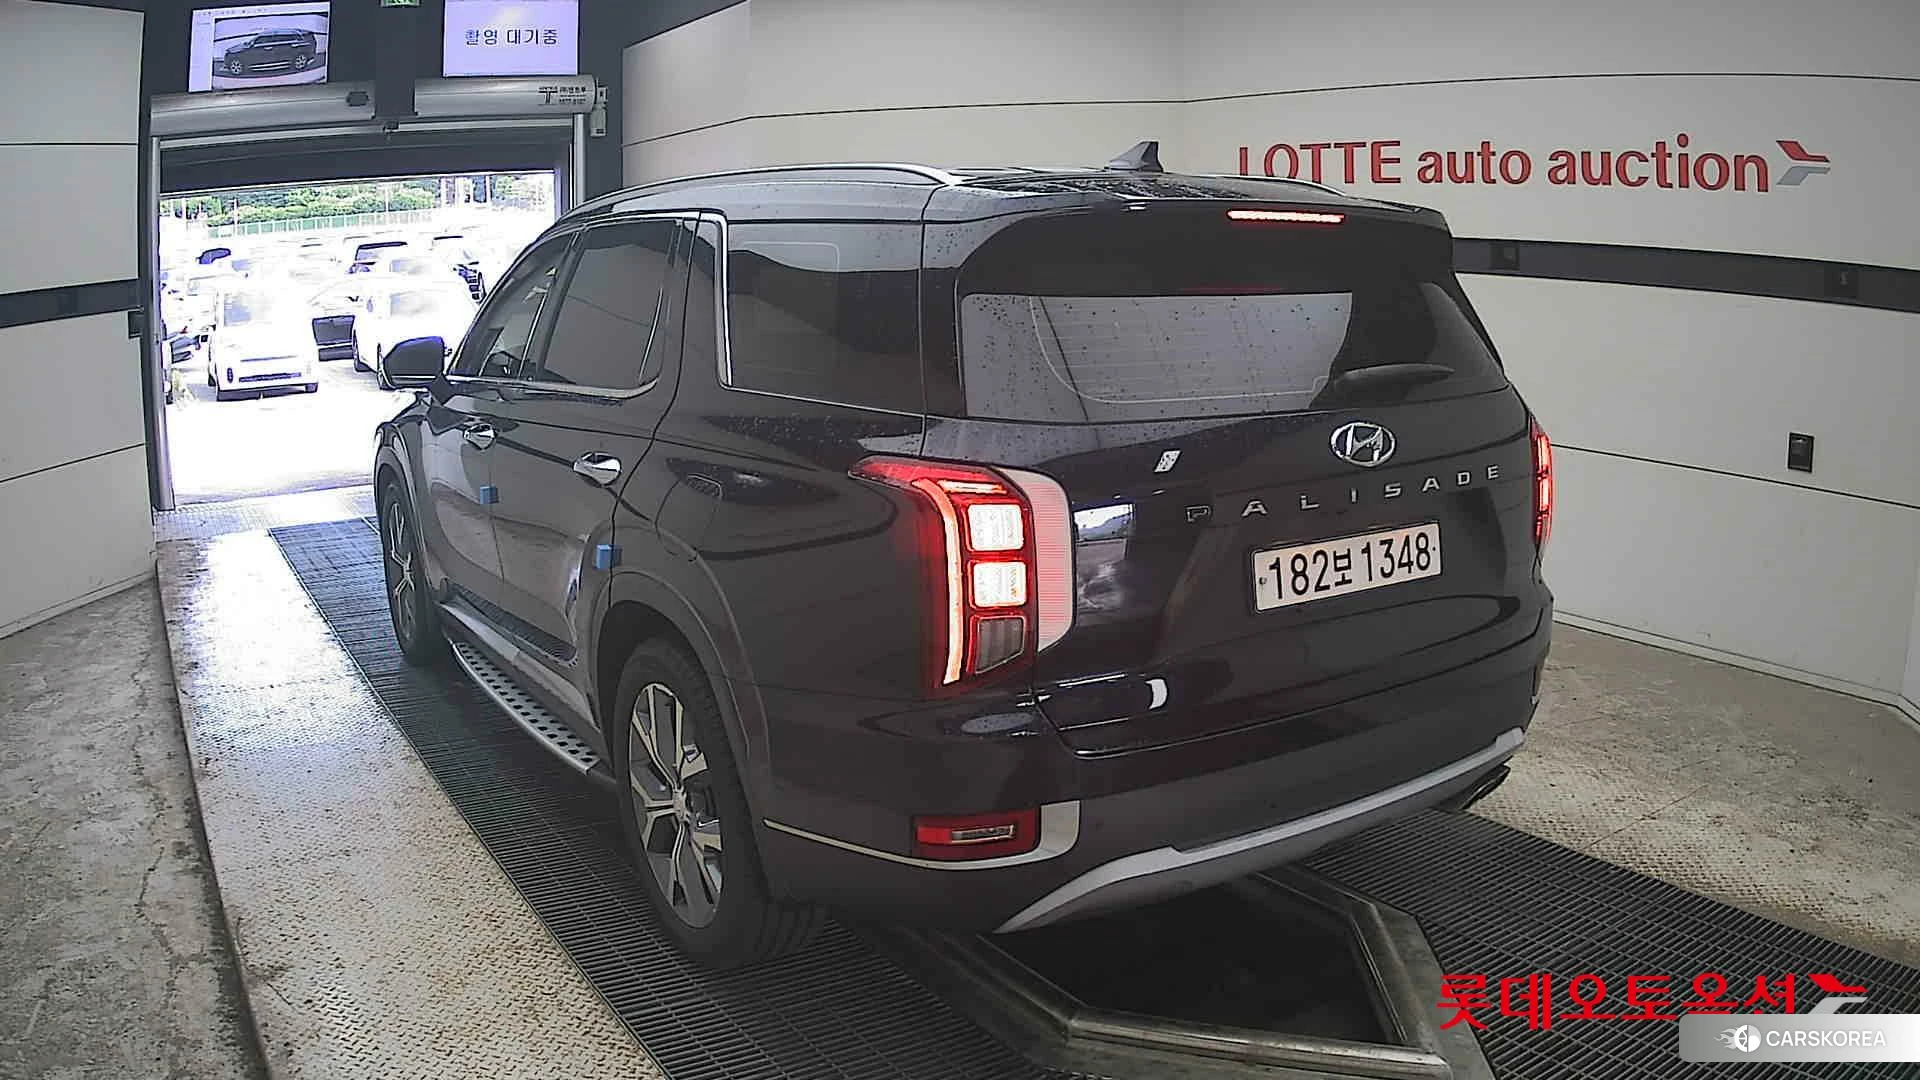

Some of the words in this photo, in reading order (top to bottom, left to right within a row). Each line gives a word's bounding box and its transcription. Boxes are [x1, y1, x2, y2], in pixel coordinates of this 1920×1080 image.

[507, 28, 559, 45] 대기중
[1417, 140, 1532, 185] auto
[1548, 133, 1769, 193] auction
[1186, 465, 1500, 522] PALISADE
